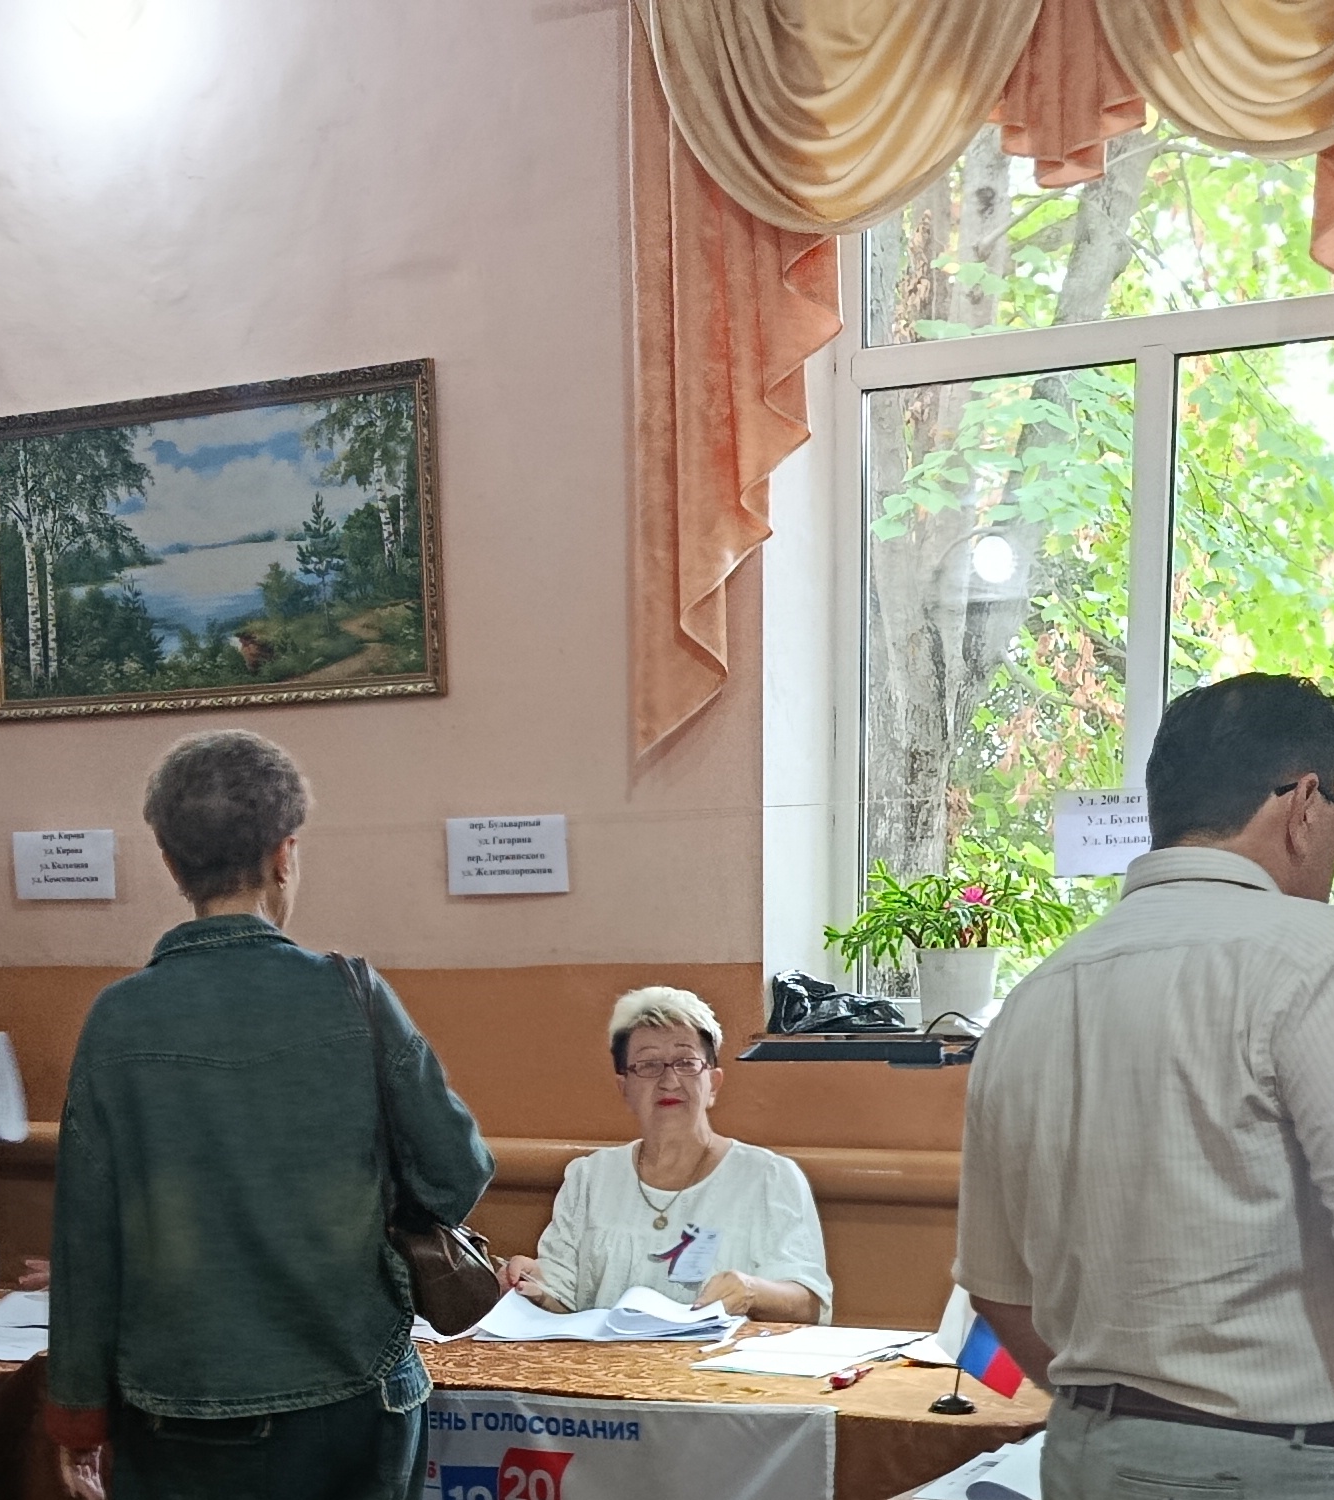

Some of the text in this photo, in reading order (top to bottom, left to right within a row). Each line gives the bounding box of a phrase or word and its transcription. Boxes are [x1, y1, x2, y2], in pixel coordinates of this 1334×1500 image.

[1100, 794, 1120, 805] 200
[492, 835, 533, 847] Гагарина
[429, 1411, 640, 1442] ЕНЬ ГОЛОСОВАНИЯ
